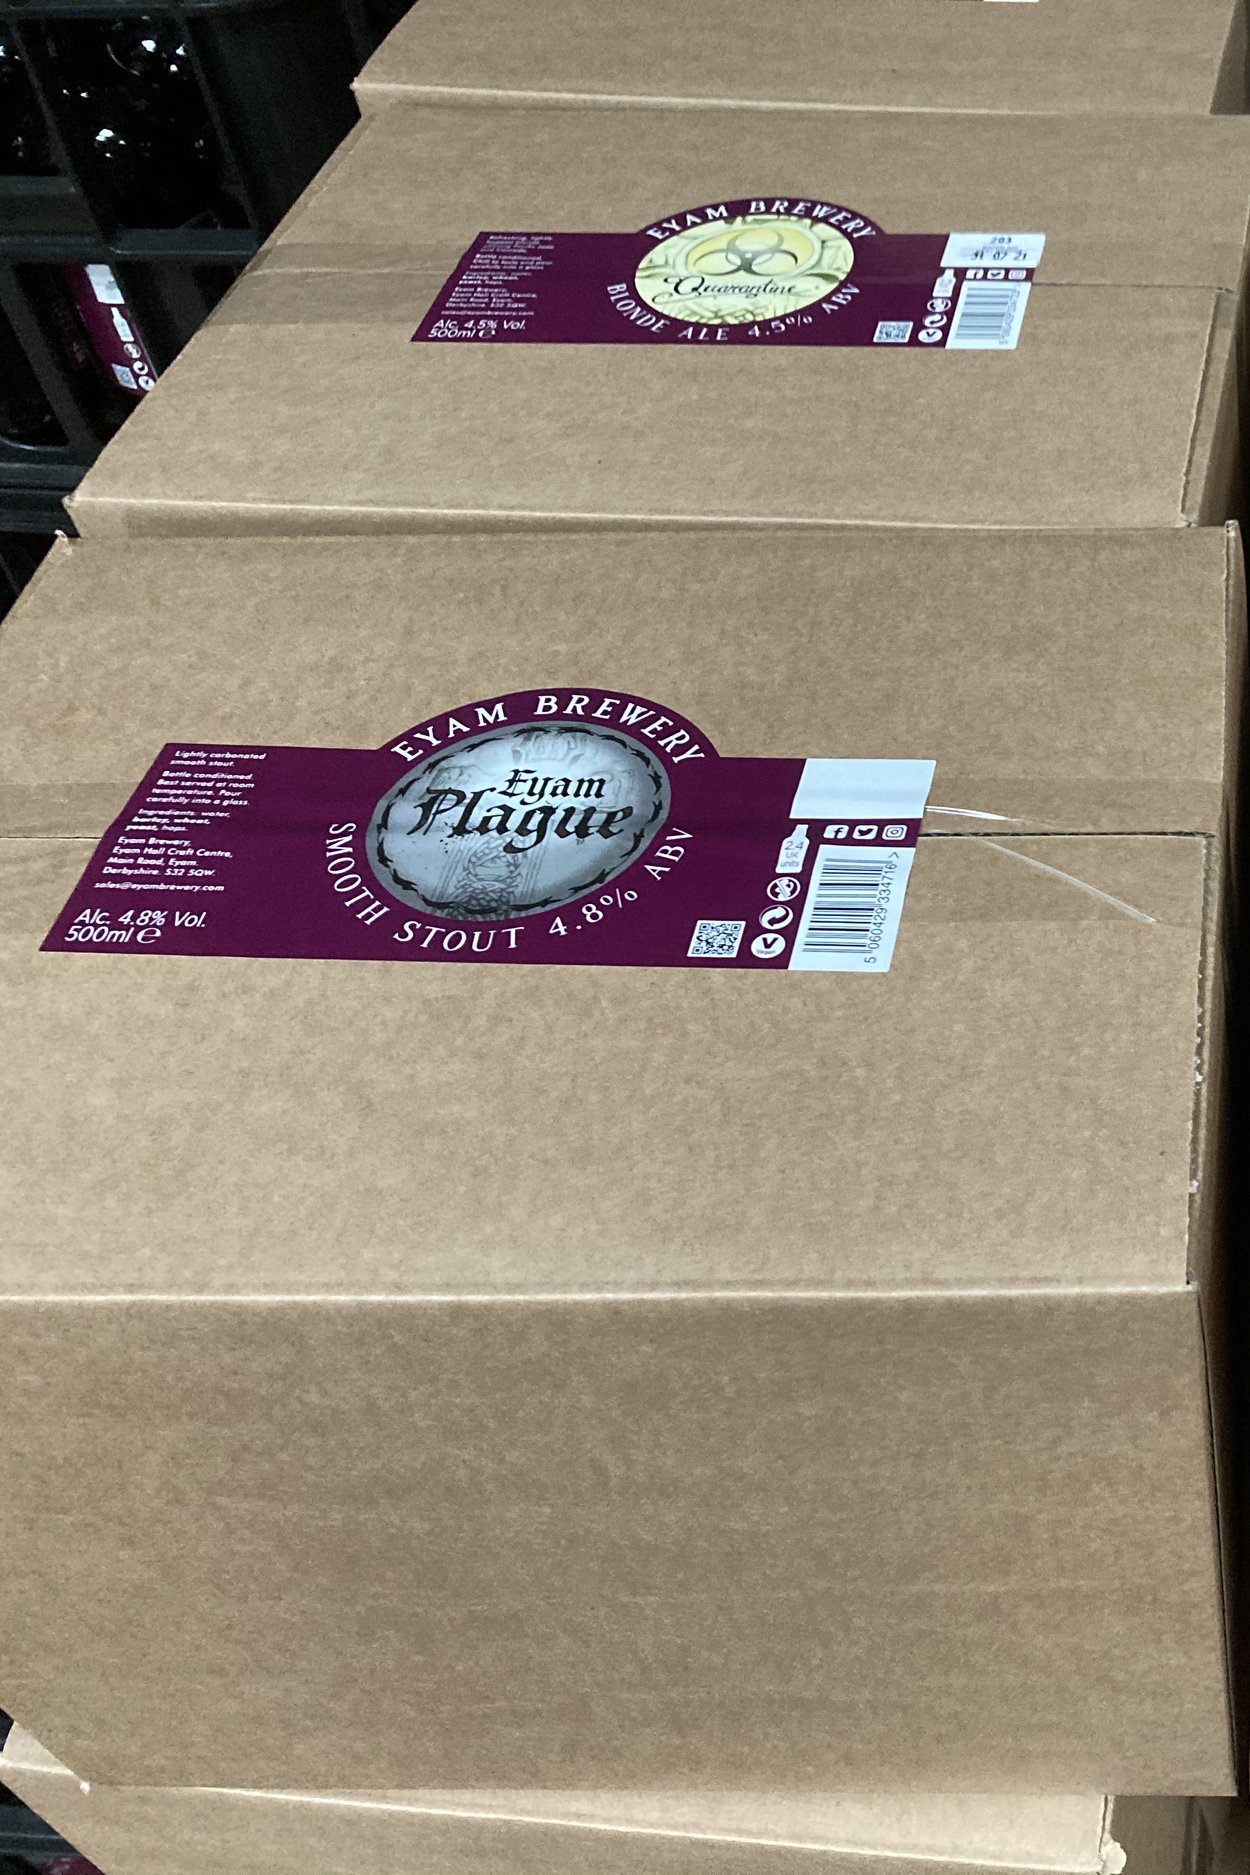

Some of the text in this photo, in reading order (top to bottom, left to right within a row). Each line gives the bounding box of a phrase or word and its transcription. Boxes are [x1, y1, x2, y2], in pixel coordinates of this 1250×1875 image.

[646, 200, 876, 240] EYAM BREWERY
[663, 276, 796, 298] Quarantine
[607, 283, 861, 341] BLONDE ALE 4.5% ABV
[464, 319, 498, 329] 4.5%
[391, 695, 705, 765] EYAM BREWERY
[209, 752, 266, 760] carbonated
[497, 769, 606, 805] Eyam
[406, 786, 634, 853] Plague
[117, 836, 145, 844] Eyam
[112, 846, 140, 854] Eyam
[143, 847, 165, 855] Hall
[167, 847, 194, 856] Craft
[164, 868, 185, 876] S32
[326, 822, 694, 952] SMOOTH STOUT 4.8% ABV
[74, 908, 207, 928] Alc. 4.8% Vol.
[64, 926, 135, 943] 500ml
